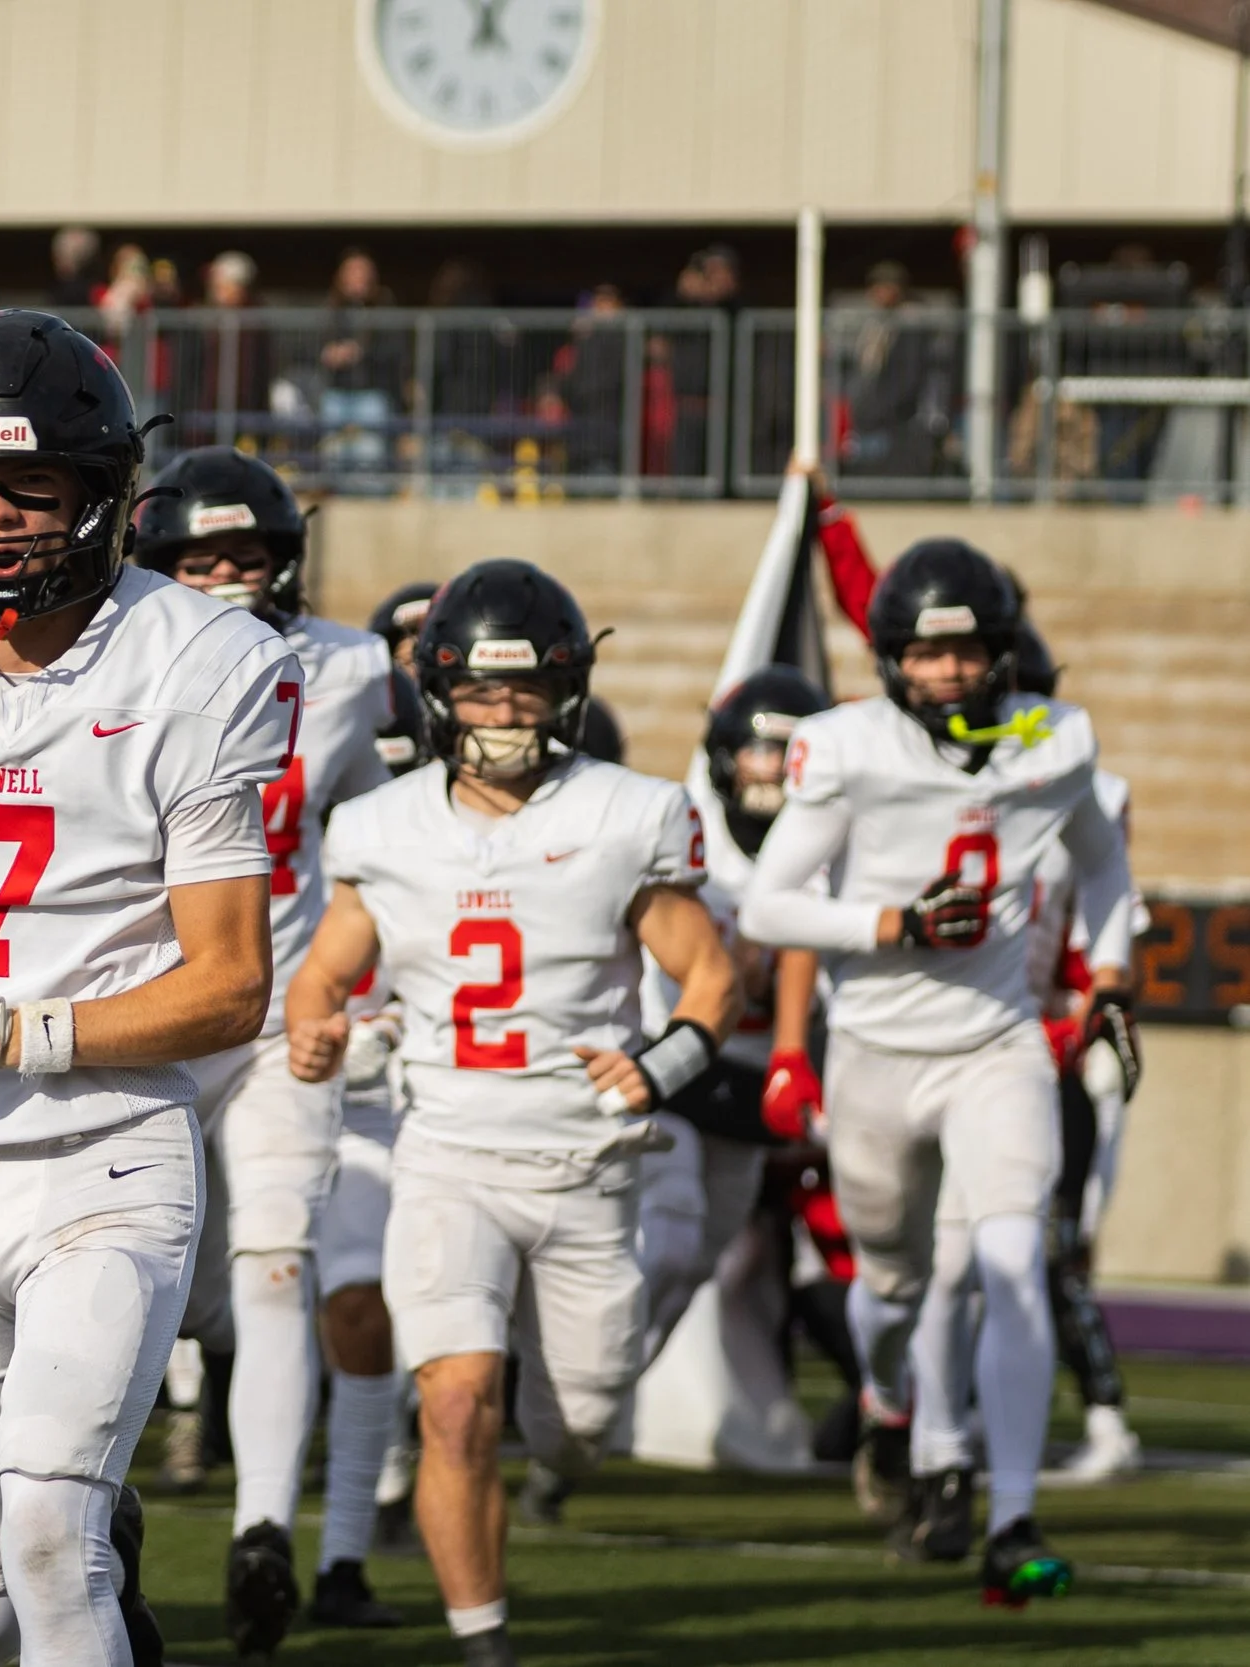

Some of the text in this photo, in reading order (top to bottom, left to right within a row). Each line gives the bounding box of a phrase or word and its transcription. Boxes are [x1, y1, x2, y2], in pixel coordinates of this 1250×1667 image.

[276, 681, 300, 769] 7
[456, 889, 514, 910] LOWELL
[448, 917, 528, 1069] 2
[1141, 902, 1250, 1010] 25
